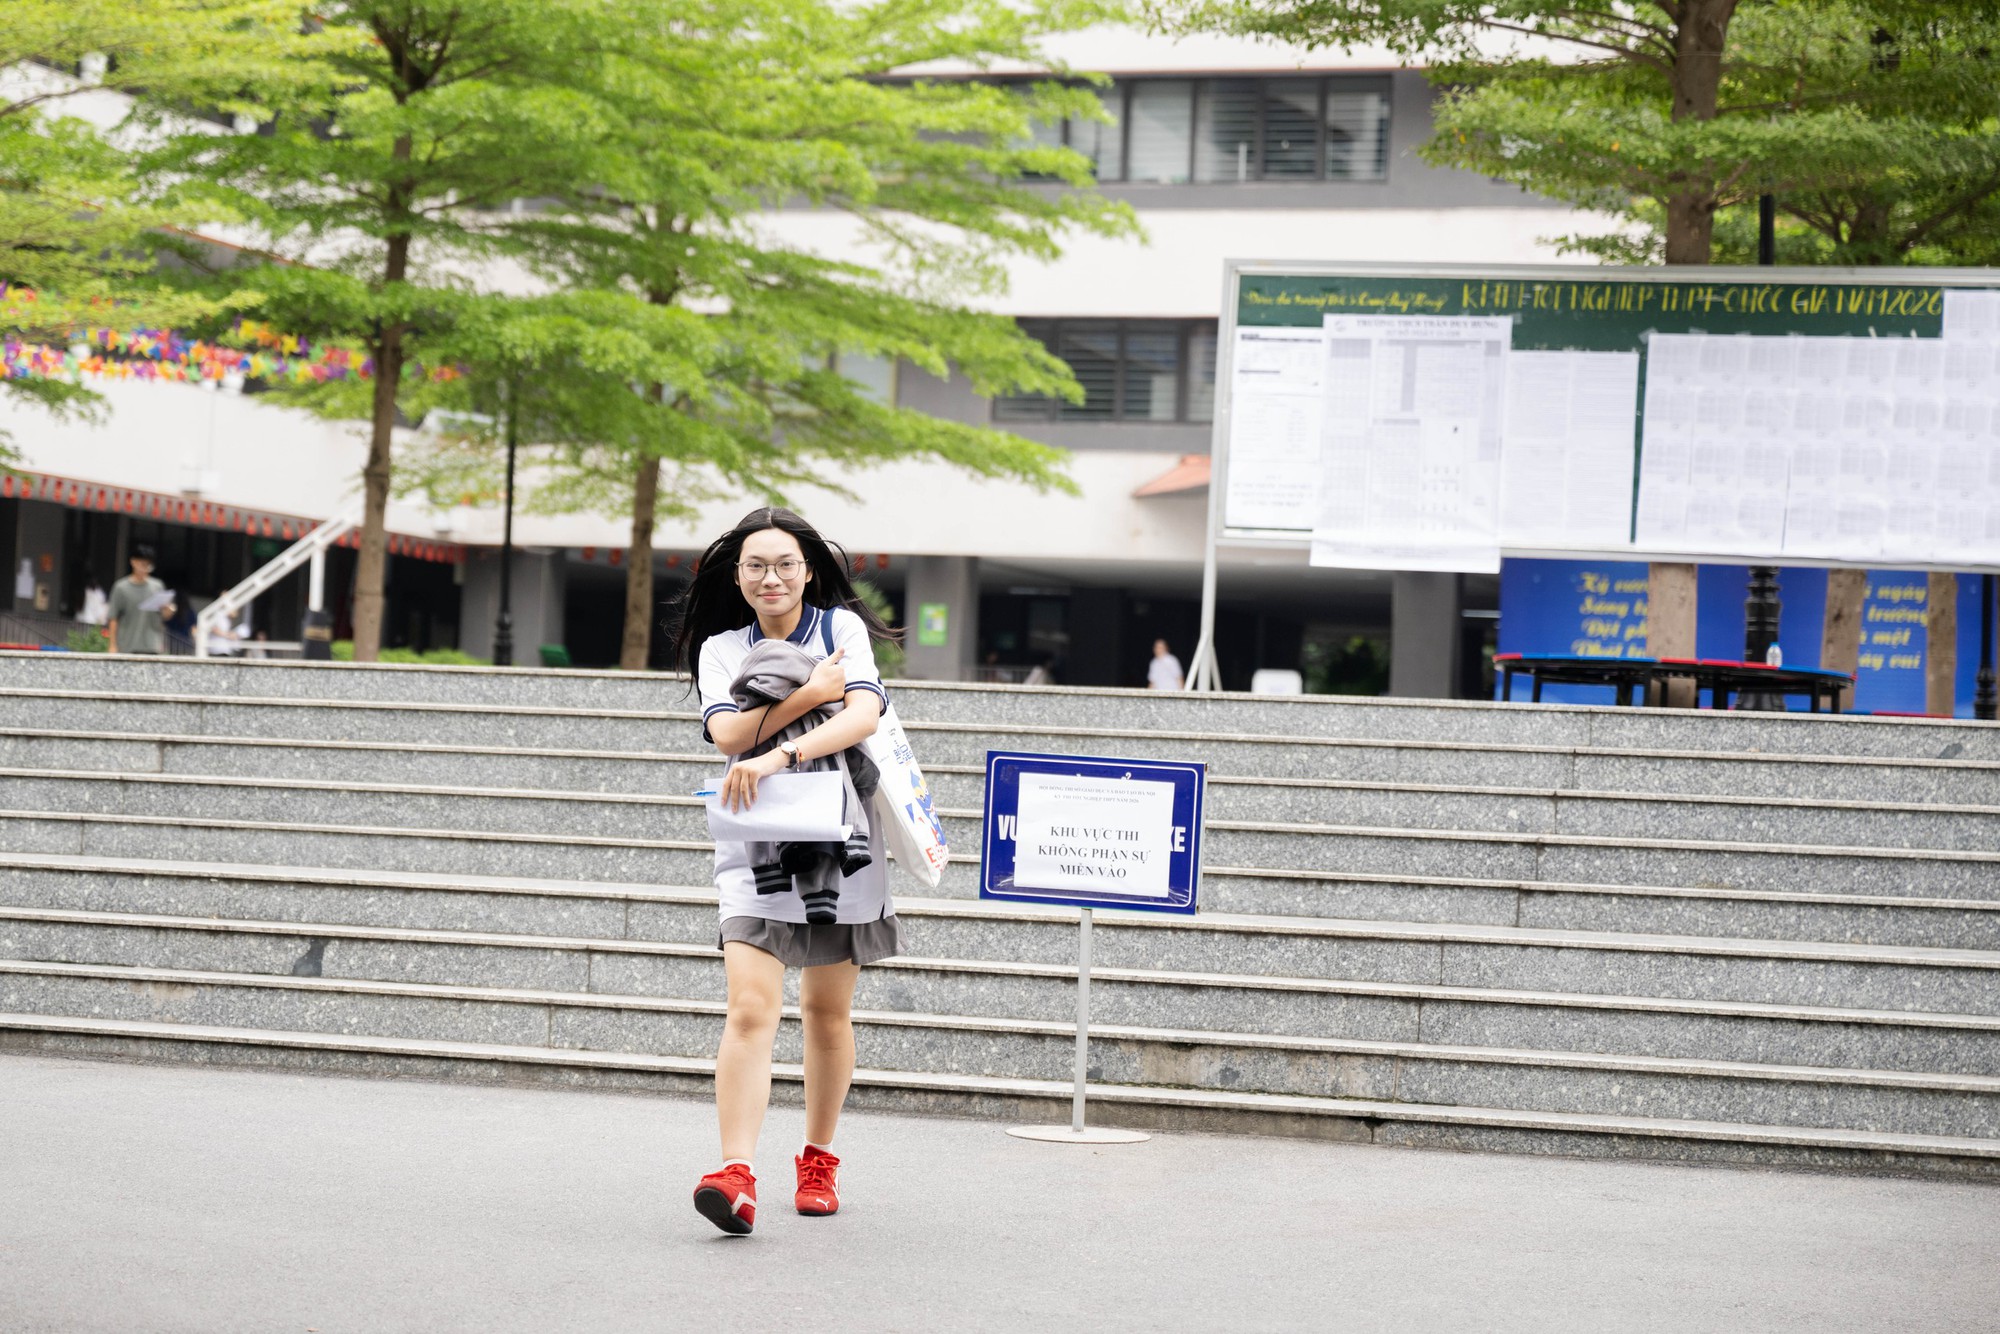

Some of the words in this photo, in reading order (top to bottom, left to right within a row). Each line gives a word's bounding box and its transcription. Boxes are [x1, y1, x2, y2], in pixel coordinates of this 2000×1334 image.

[1050, 826, 1079, 838] KHU
[1083, 827, 1112, 841] VỰC
[1116, 830, 1139, 841] THI
[1038, 844, 1087, 858] KHÔNG
[1131, 850, 1151, 864] SỰ
[1098, 865, 1127, 879] VÀO
